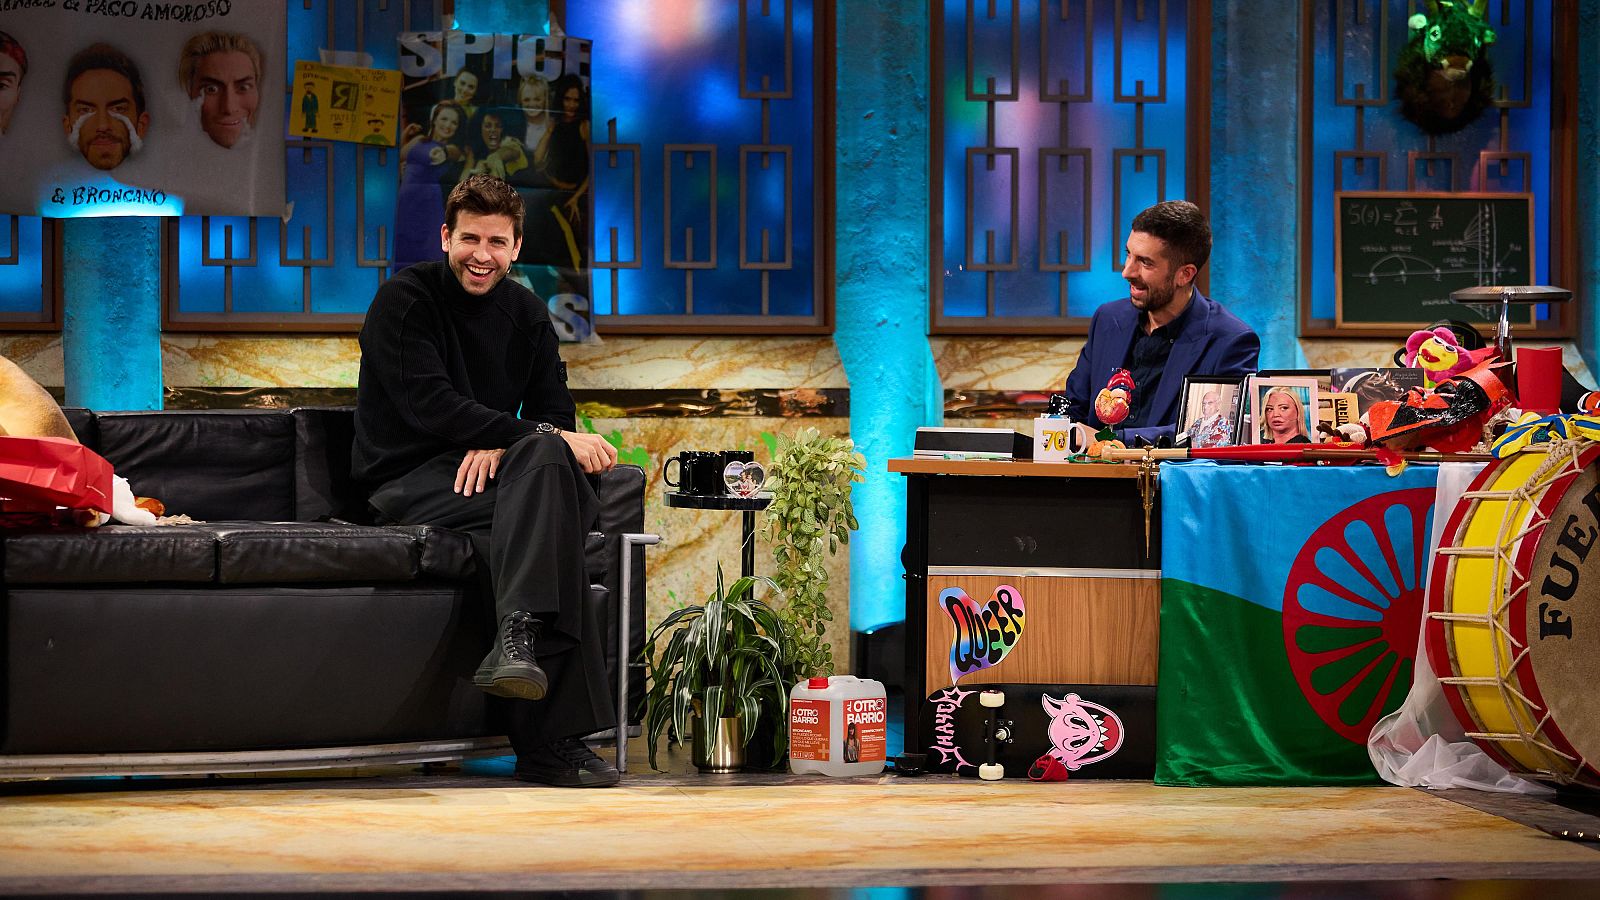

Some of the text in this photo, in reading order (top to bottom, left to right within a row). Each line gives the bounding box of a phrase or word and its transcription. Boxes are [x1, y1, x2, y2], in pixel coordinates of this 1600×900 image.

[140, 0, 232, 22] AMOROSO
[51, 186, 167, 206] & BRONCANO
[945, 589, 1024, 673] QUEER
[796, 708, 819, 717] OTRO
[854, 699, 884, 712] OTRO
[792, 715, 819, 725] BARRIO
[847, 711, 884, 725] BARRIO
